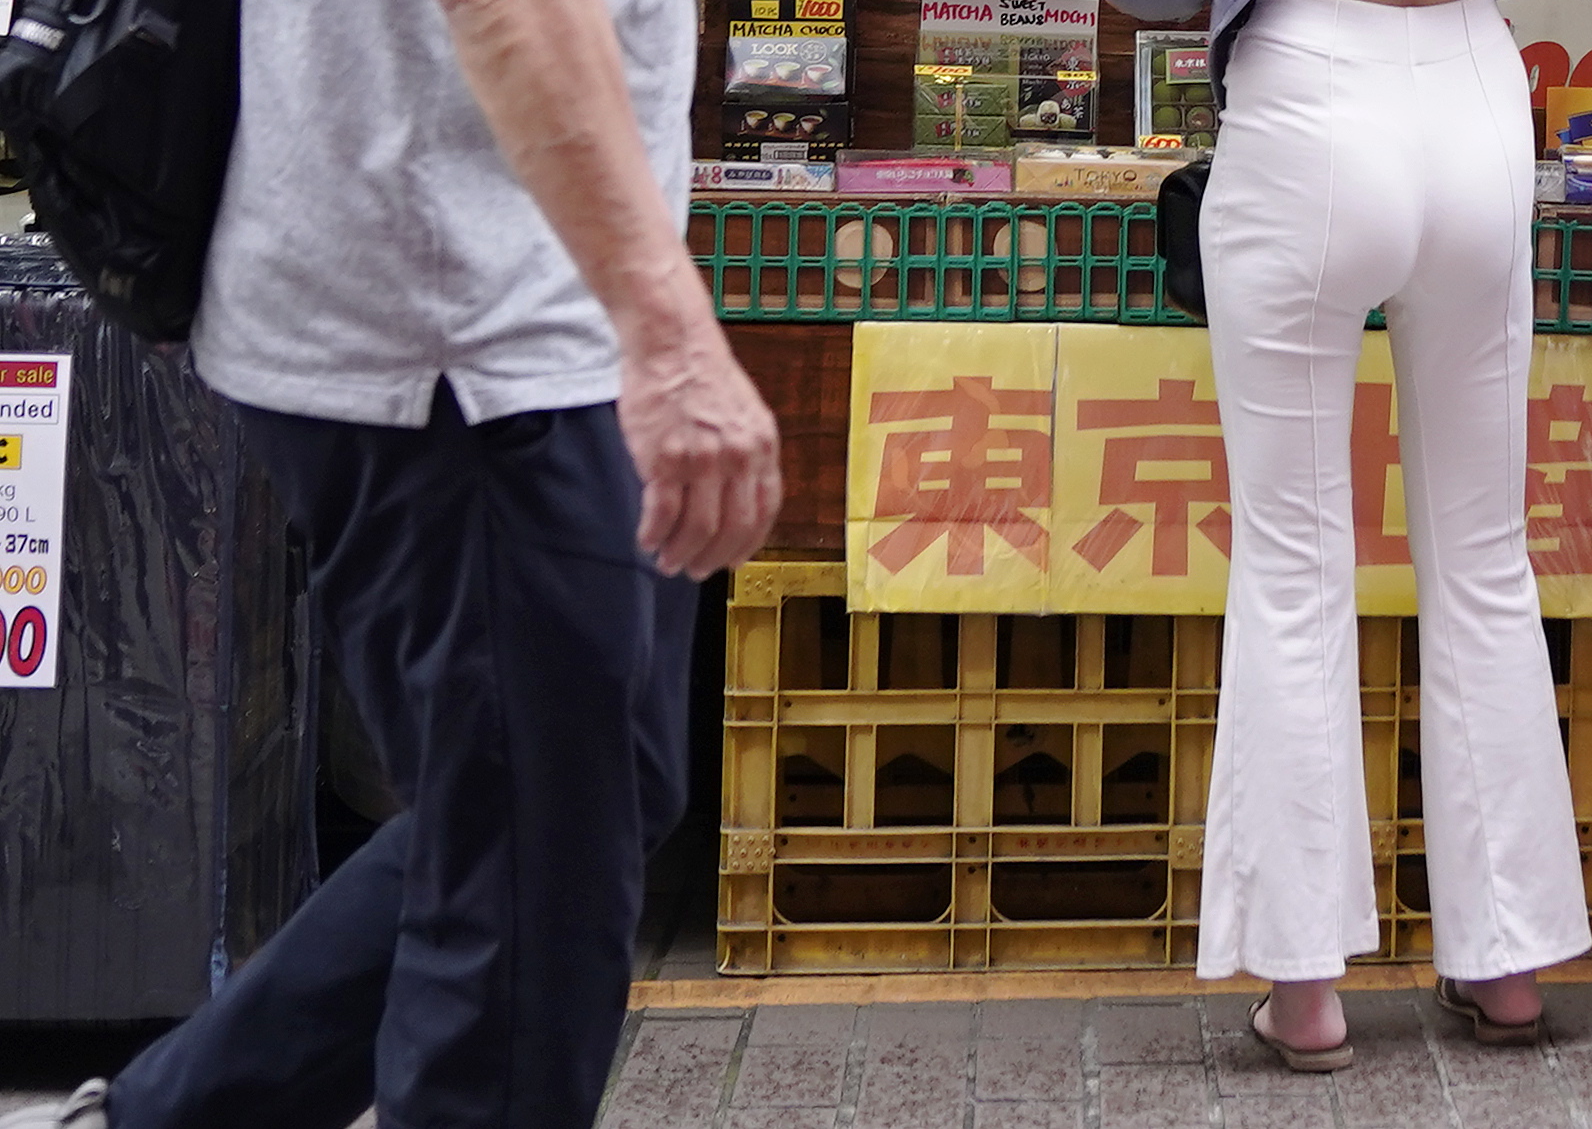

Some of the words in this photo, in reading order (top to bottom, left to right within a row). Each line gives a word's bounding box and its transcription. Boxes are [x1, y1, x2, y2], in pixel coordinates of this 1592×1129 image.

[922, 0, 994, 24] MATCHA
[1044, 7, 1097, 28] MOCHI
[732, 22, 794, 38] MATCHA
[800, 24, 845, 36] CHOCO
[750, 43, 799, 56] LOOK
[1073, 167, 1138, 183] TOKYO
[16, 365, 55, 384] sale
[0, 605, 48, 678] 0
